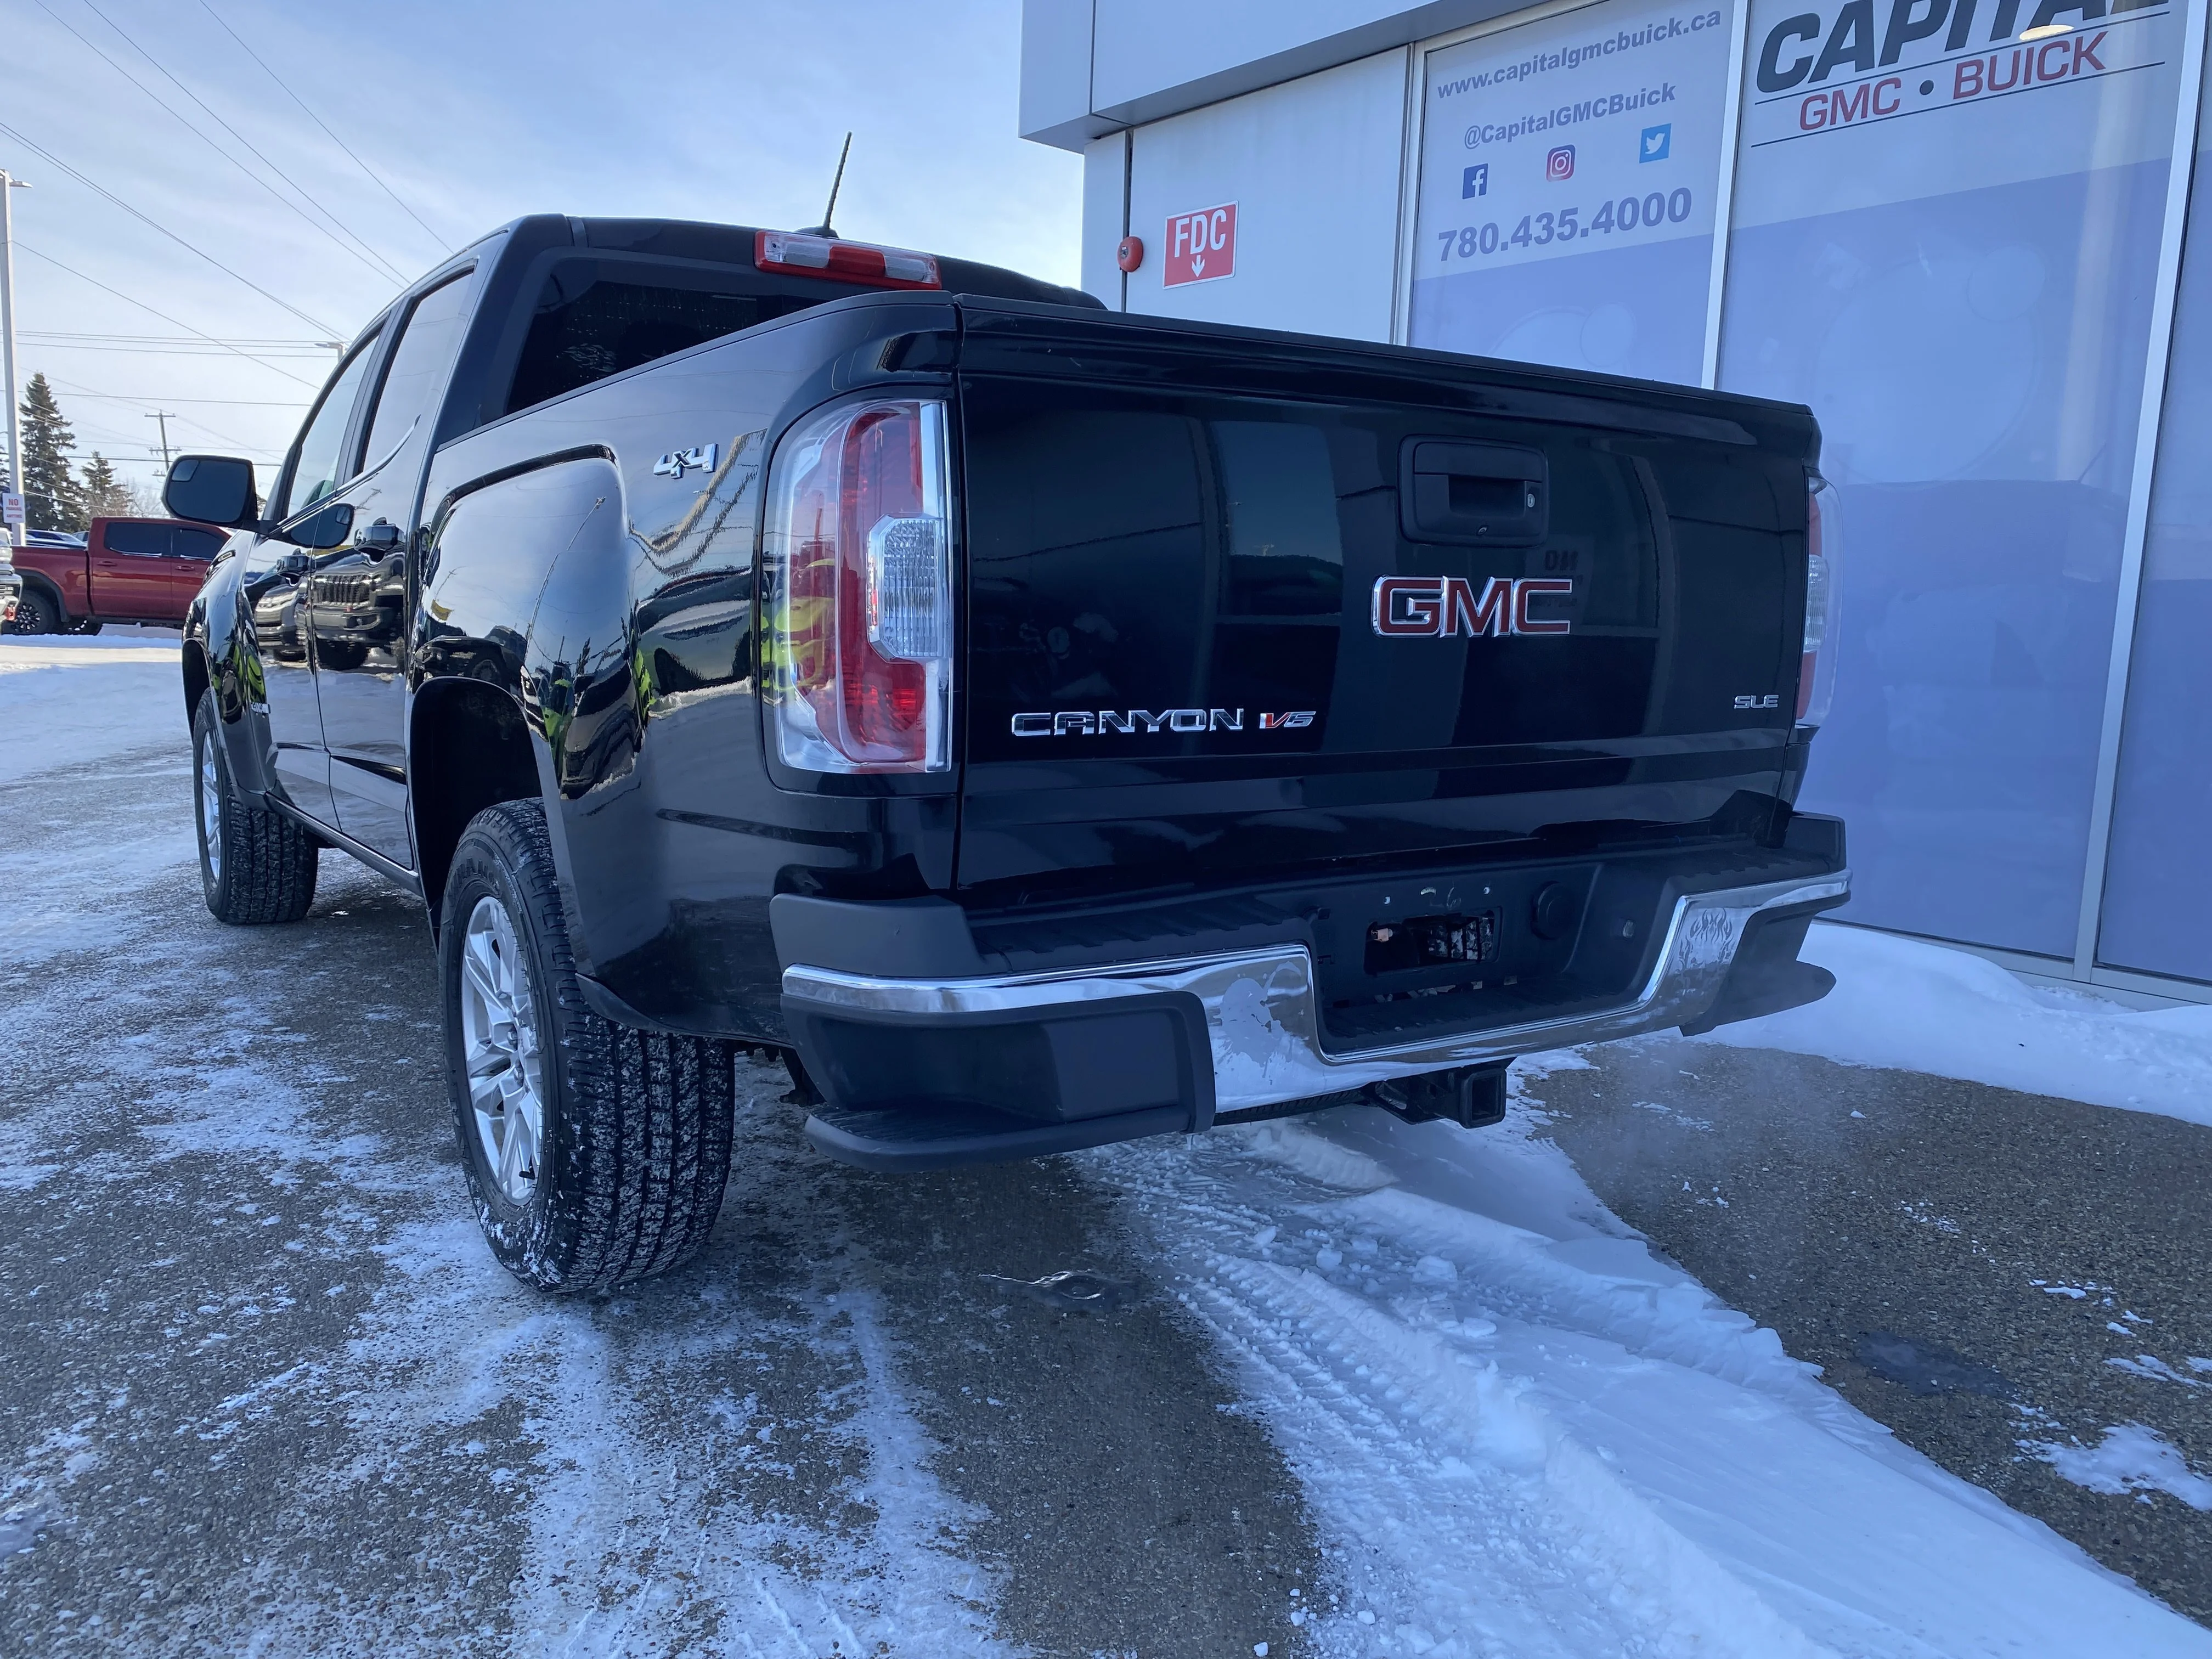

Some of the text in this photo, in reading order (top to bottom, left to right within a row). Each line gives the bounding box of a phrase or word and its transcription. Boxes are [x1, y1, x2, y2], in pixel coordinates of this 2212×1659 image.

[1437, 10, 1721, 98] www.capitalgmcbuick.ca
[1757, 0, 2169, 93] CAPI
[1800, 31, 2109, 130] GMC BUICK
[1464, 82, 1676, 149] @CapitalGMCBuick
[1174, 209, 1226, 257] FDC
[1438, 187, 1692, 262] 780.435.4000
[1373, 575, 1573, 637] GMC
[1011, 708, 1317, 736] CANYON V6
[1734, 695, 1779, 709] SLE
